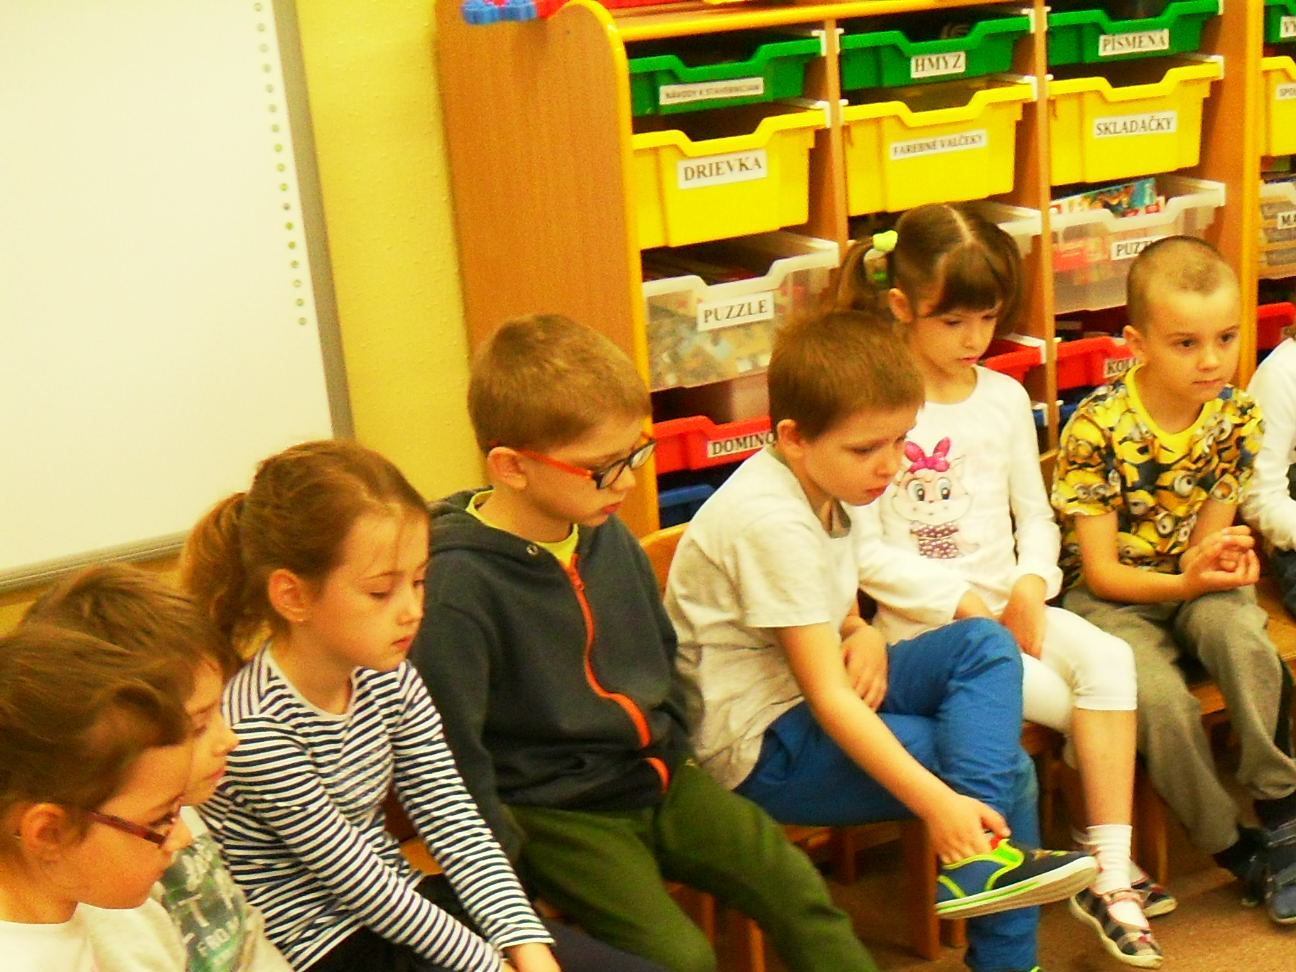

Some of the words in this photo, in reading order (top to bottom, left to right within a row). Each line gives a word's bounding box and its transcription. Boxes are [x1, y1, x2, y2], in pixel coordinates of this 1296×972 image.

[914, 53, 964, 74] HMYZ
[1095, 115, 1174, 137] SKLADAČKY
[683, 156, 763, 182] DRIEVKA
[703, 299, 768, 323] PUZZLE
[711, 431, 776, 456] DOMINO
